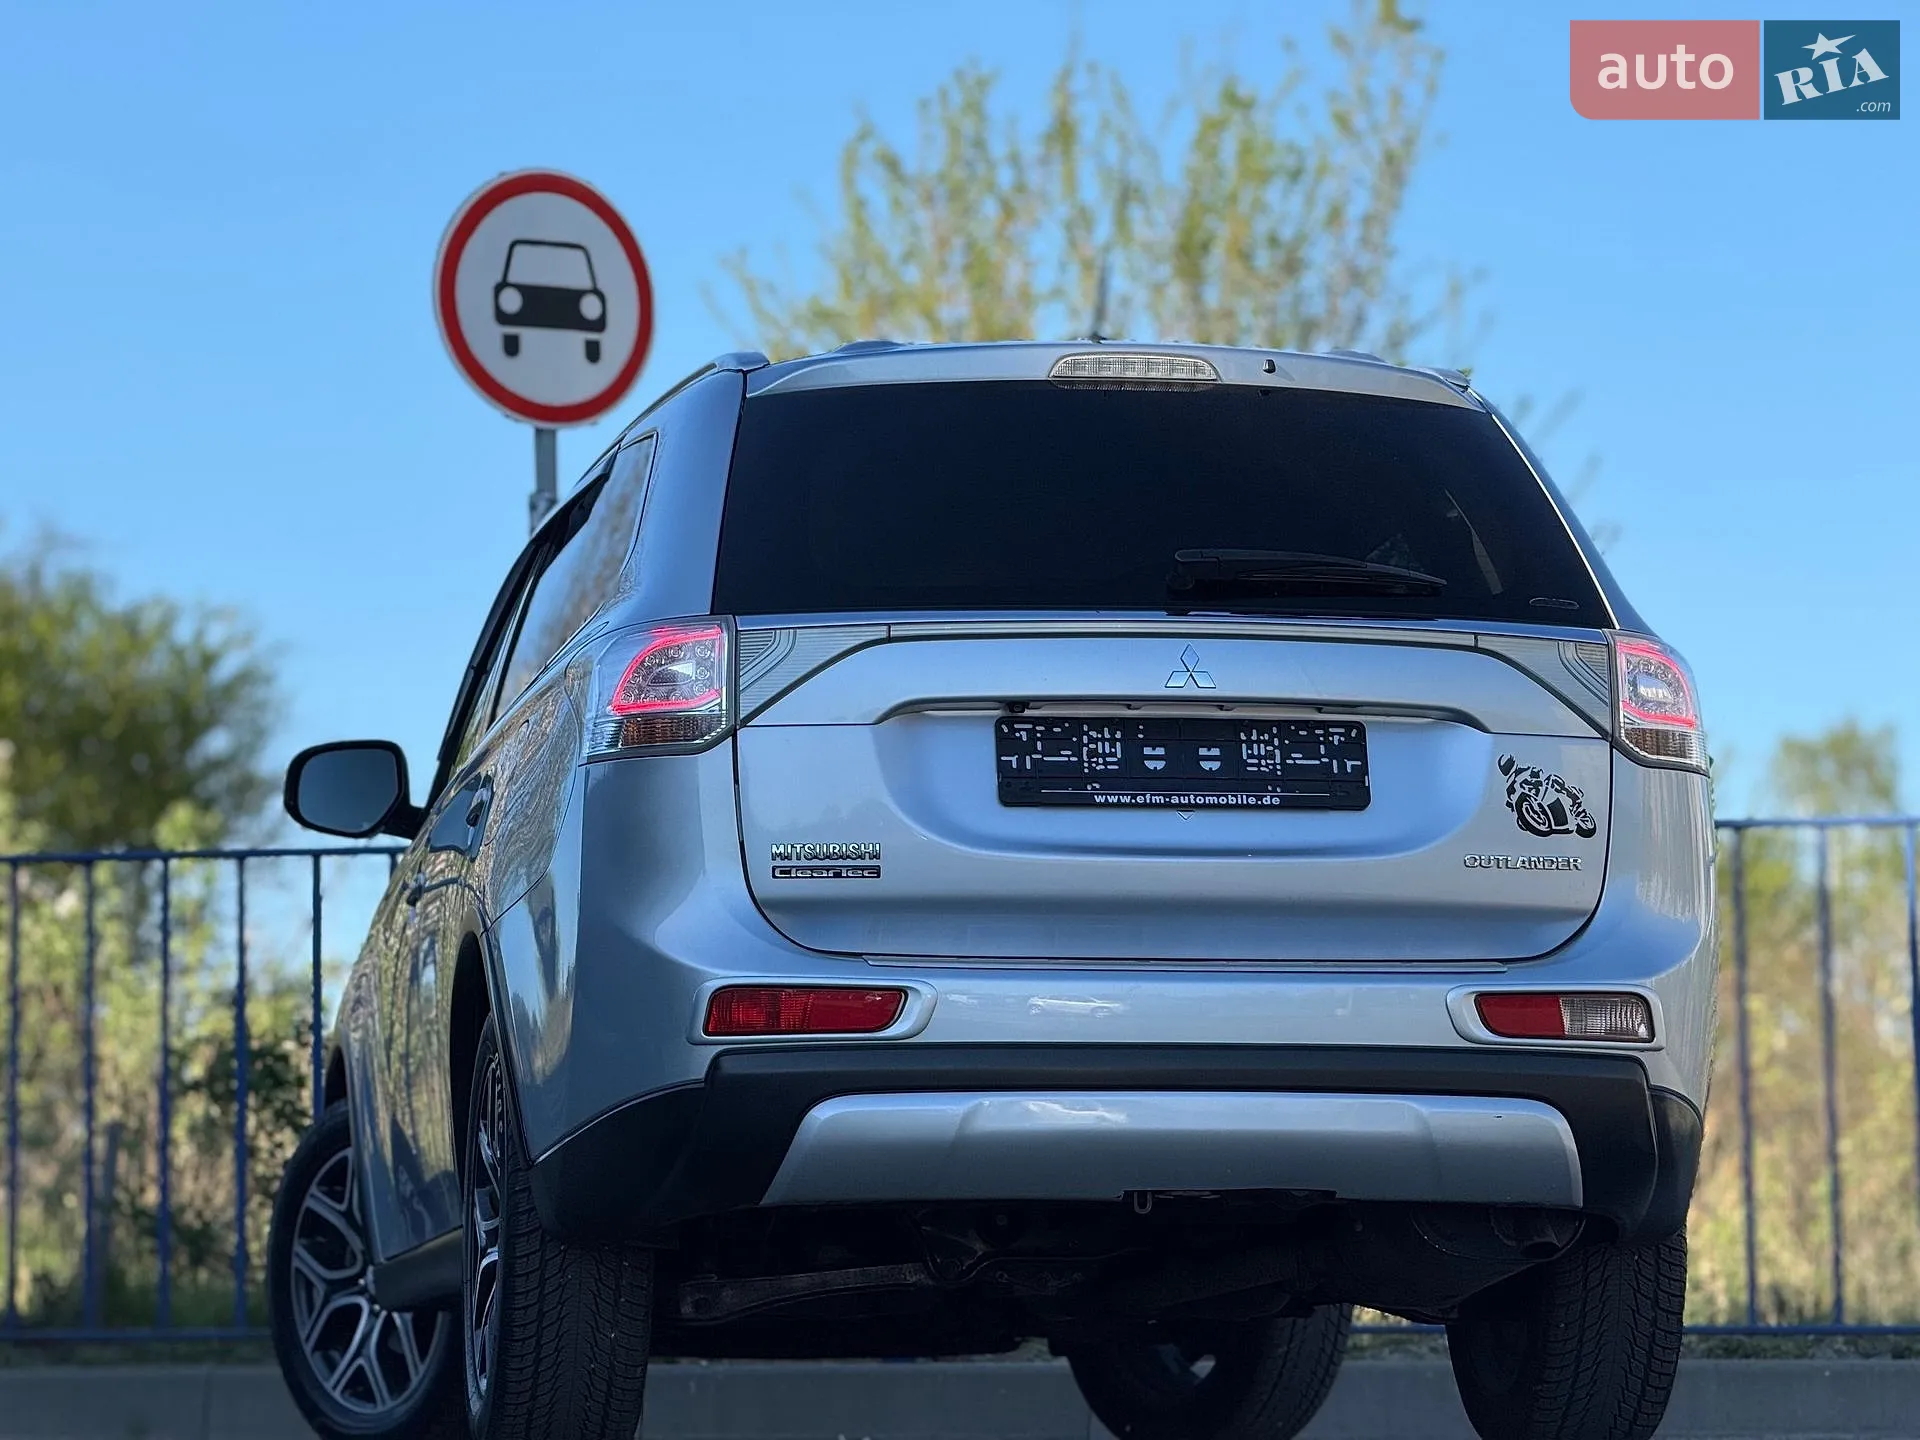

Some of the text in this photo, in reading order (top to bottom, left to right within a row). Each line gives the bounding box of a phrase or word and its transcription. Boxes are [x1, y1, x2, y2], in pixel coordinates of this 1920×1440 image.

[1094, 793, 1281, 806] www.efm-automobile.de
[771, 842, 880, 860] MITSUBISHI
[1464, 854, 1583, 871] OUTLANDER
[774, 866, 879, 878] ClearTec
